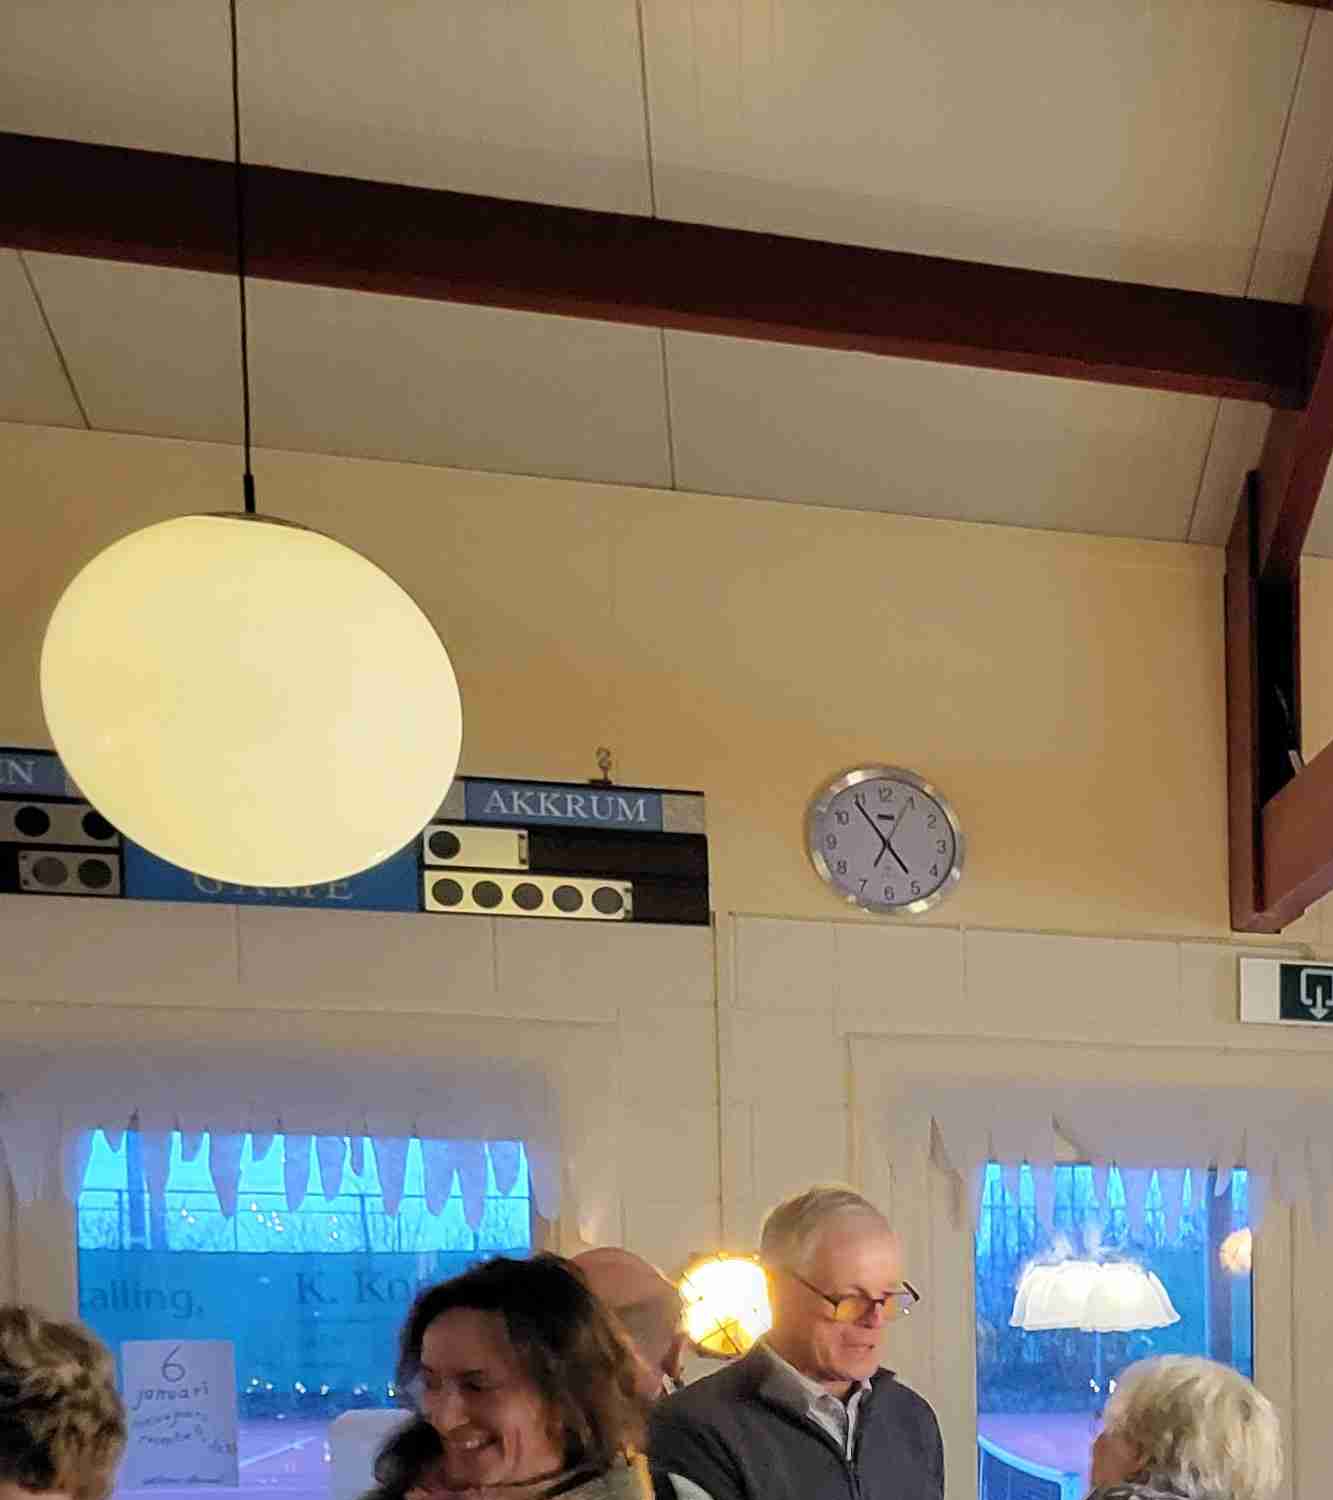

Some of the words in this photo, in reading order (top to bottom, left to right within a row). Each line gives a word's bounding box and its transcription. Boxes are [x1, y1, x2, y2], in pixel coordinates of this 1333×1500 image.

[879, 787, 894, 802] 12
[482, 789, 649, 823] AKKRUM
[835, 811, 849, 825] 10
[927, 815, 937, 829] 2
[826, 835, 837, 849] 9
[936, 840, 946, 854] 3
[837, 860, 848, 874] 8
[929, 864, 938, 877] 4
[859, 879, 868, 893] 7
[910, 881, 921, 896] 5
[884, 886, 895, 901] 6
[295, 1272, 339, 1304] K.
[161, 1344, 186, 1382] 6
[131, 1380, 209, 1411] januari
